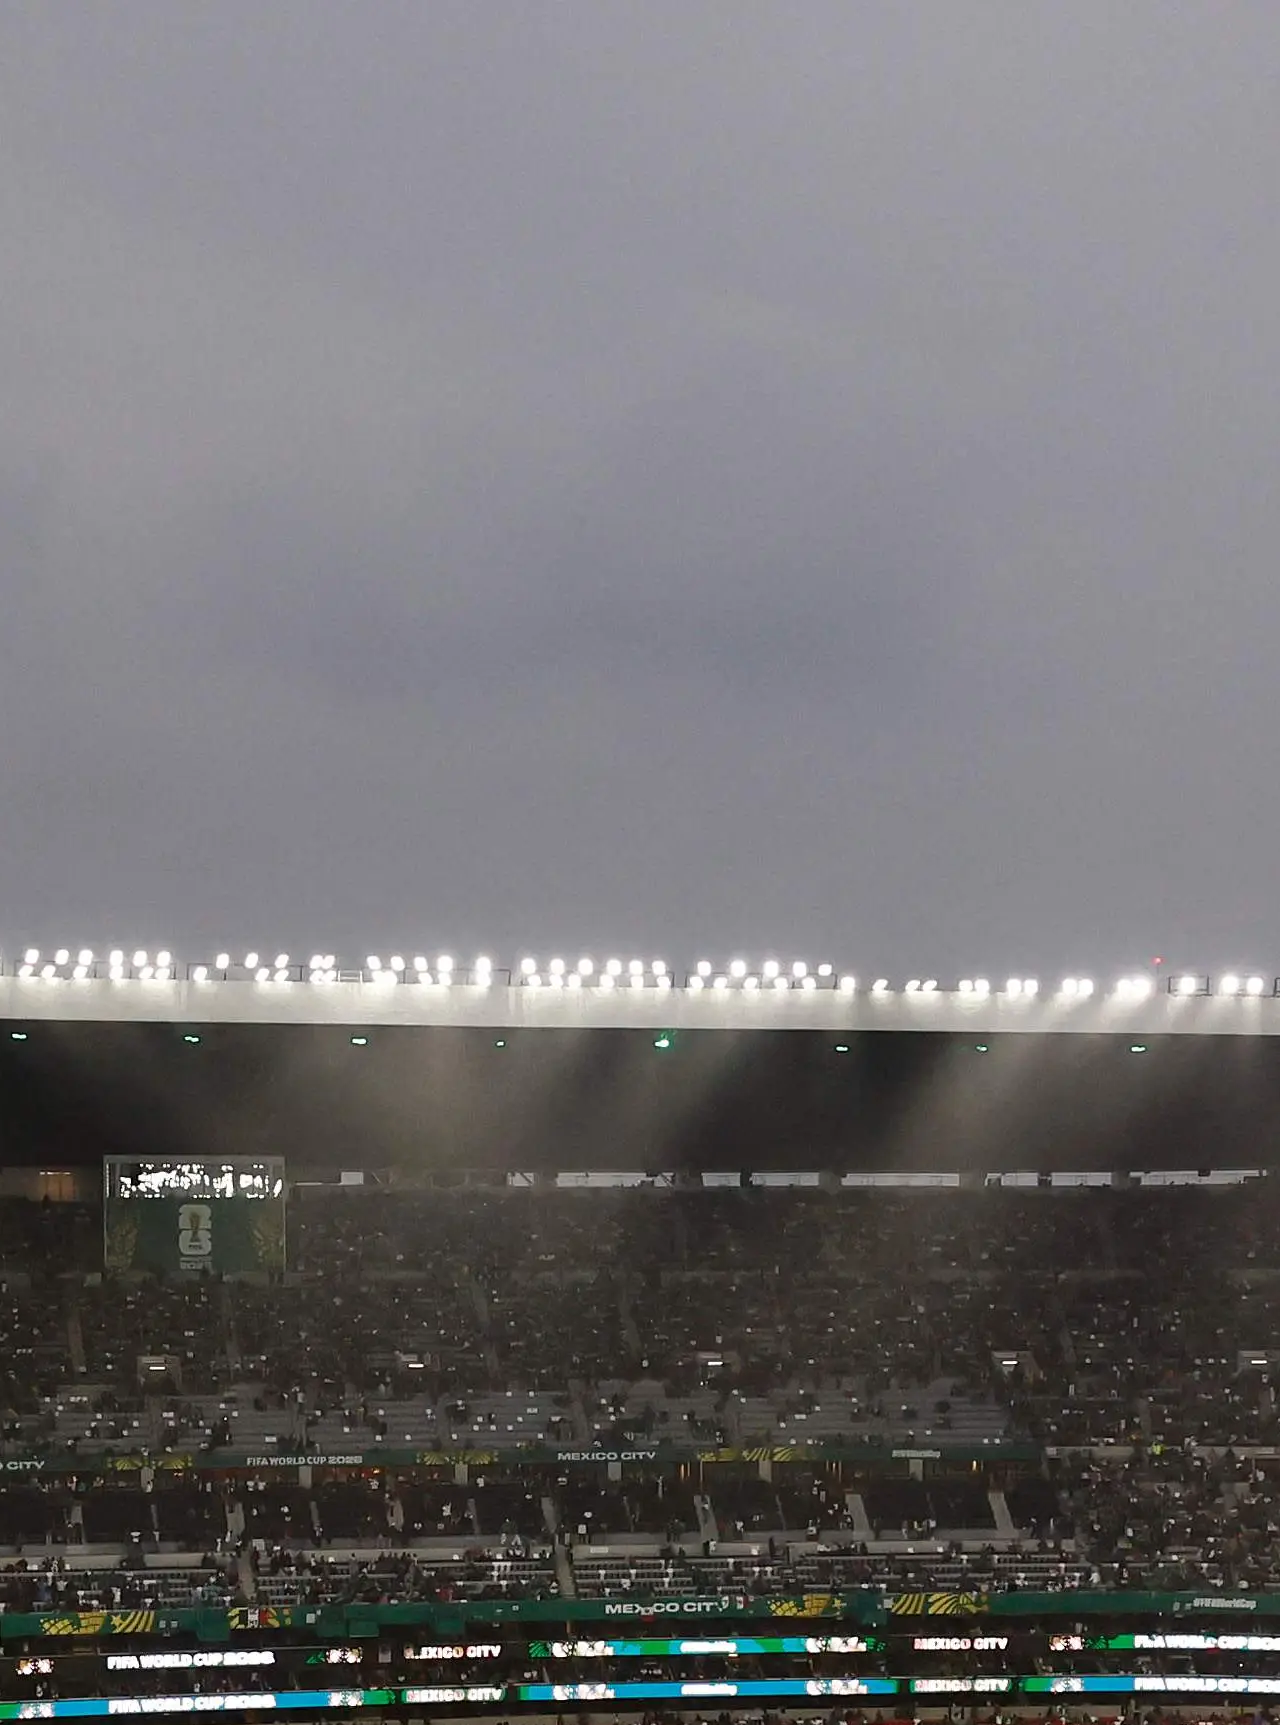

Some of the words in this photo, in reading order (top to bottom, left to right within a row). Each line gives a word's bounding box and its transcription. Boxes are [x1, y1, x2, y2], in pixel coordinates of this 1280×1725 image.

[246, 1457, 269, 1467] FIFA
[270, 1456, 305, 1466] WORLD
[306, 1456, 327, 1465] CUP
[557, 1452, 617, 1462] MEXICO
[620, 1451, 656, 1461] CITY
[6, 1460, 45, 1471] CITY
[913, 1637, 971, 1650] MEXICO
[973, 1638, 1009, 1650] CITY
[466, 1645, 502, 1658] CITY
[107, 1656, 139, 1670] FIFA
[140, 1654, 192, 1668] WORLD
[193, 1653, 223, 1666] CUP
[406, 1688, 465, 1703] MEXICO
[468, 1687, 504, 1702] CITY
[108, 1699, 140, 1714] FIFA
